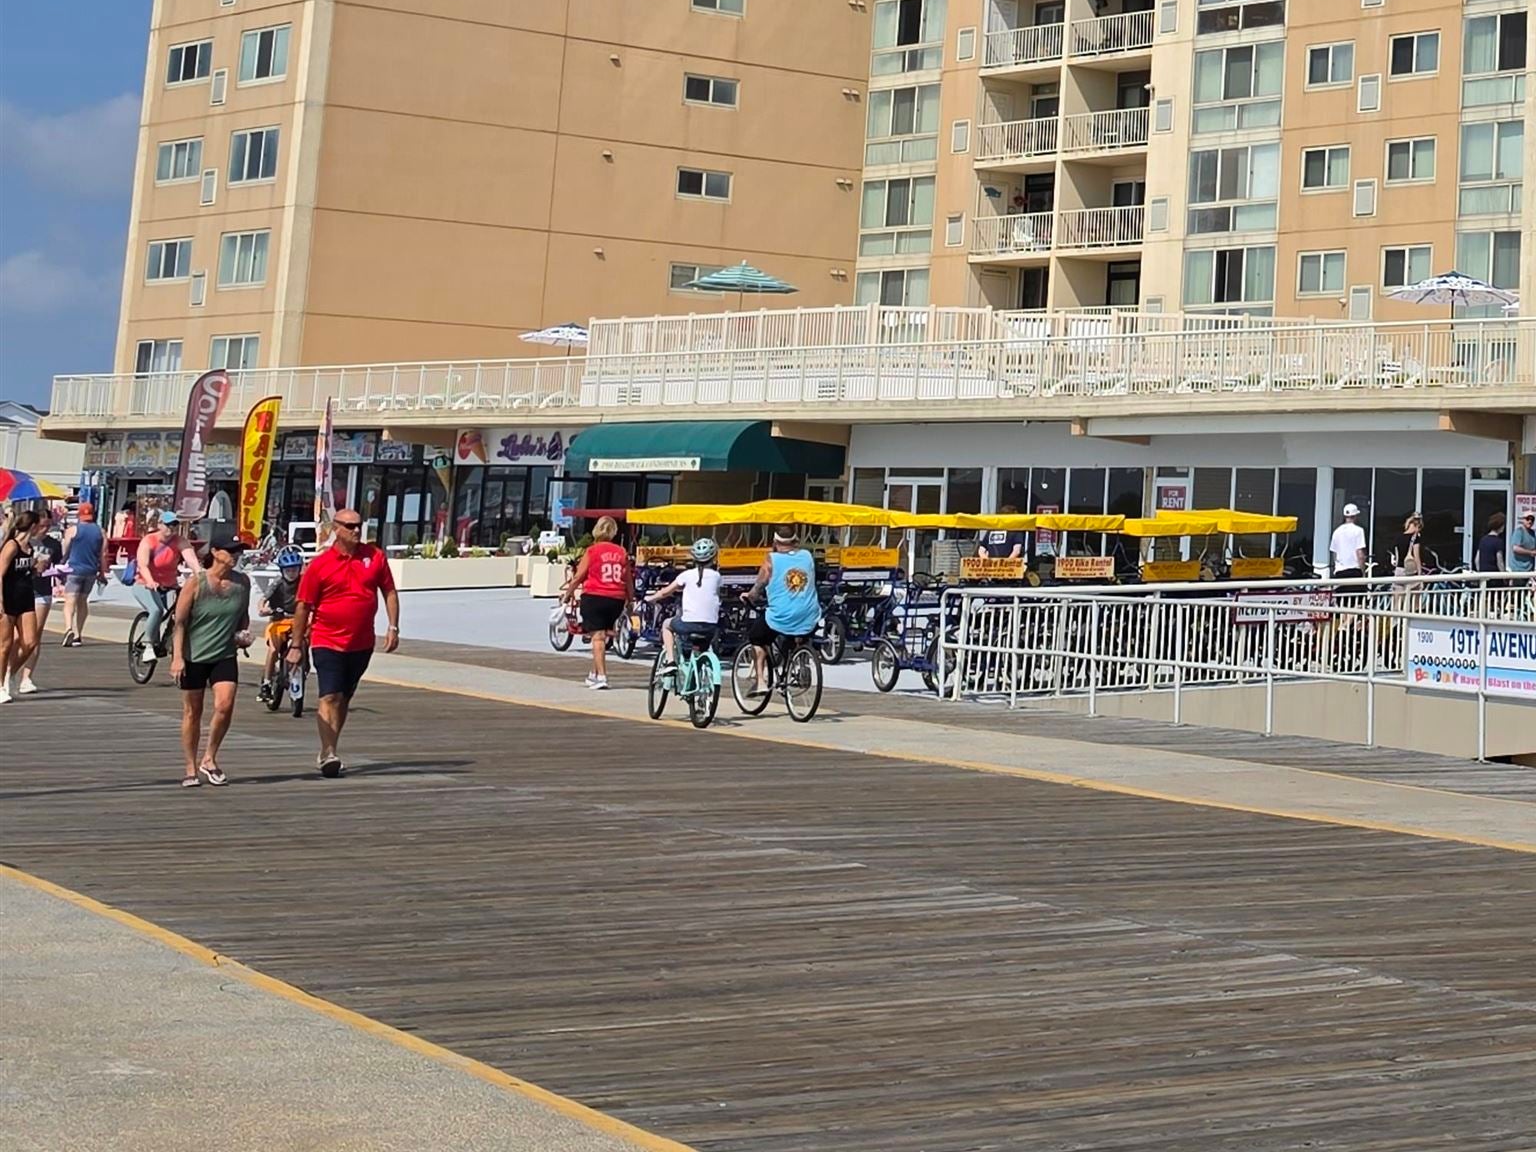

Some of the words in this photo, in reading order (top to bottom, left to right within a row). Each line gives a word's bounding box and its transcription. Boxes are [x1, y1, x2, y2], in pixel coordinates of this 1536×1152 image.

[1162, 497, 1185, 509] RENT
[963, 559, 981, 567] 1900
[1058, 559, 1074, 567] 1900
[1417, 631, 1434, 644] 1900
[1488, 677, 1510, 688] Blast
[1511, 680, 1521, 688] on
[1523, 680, 1536, 691] the
